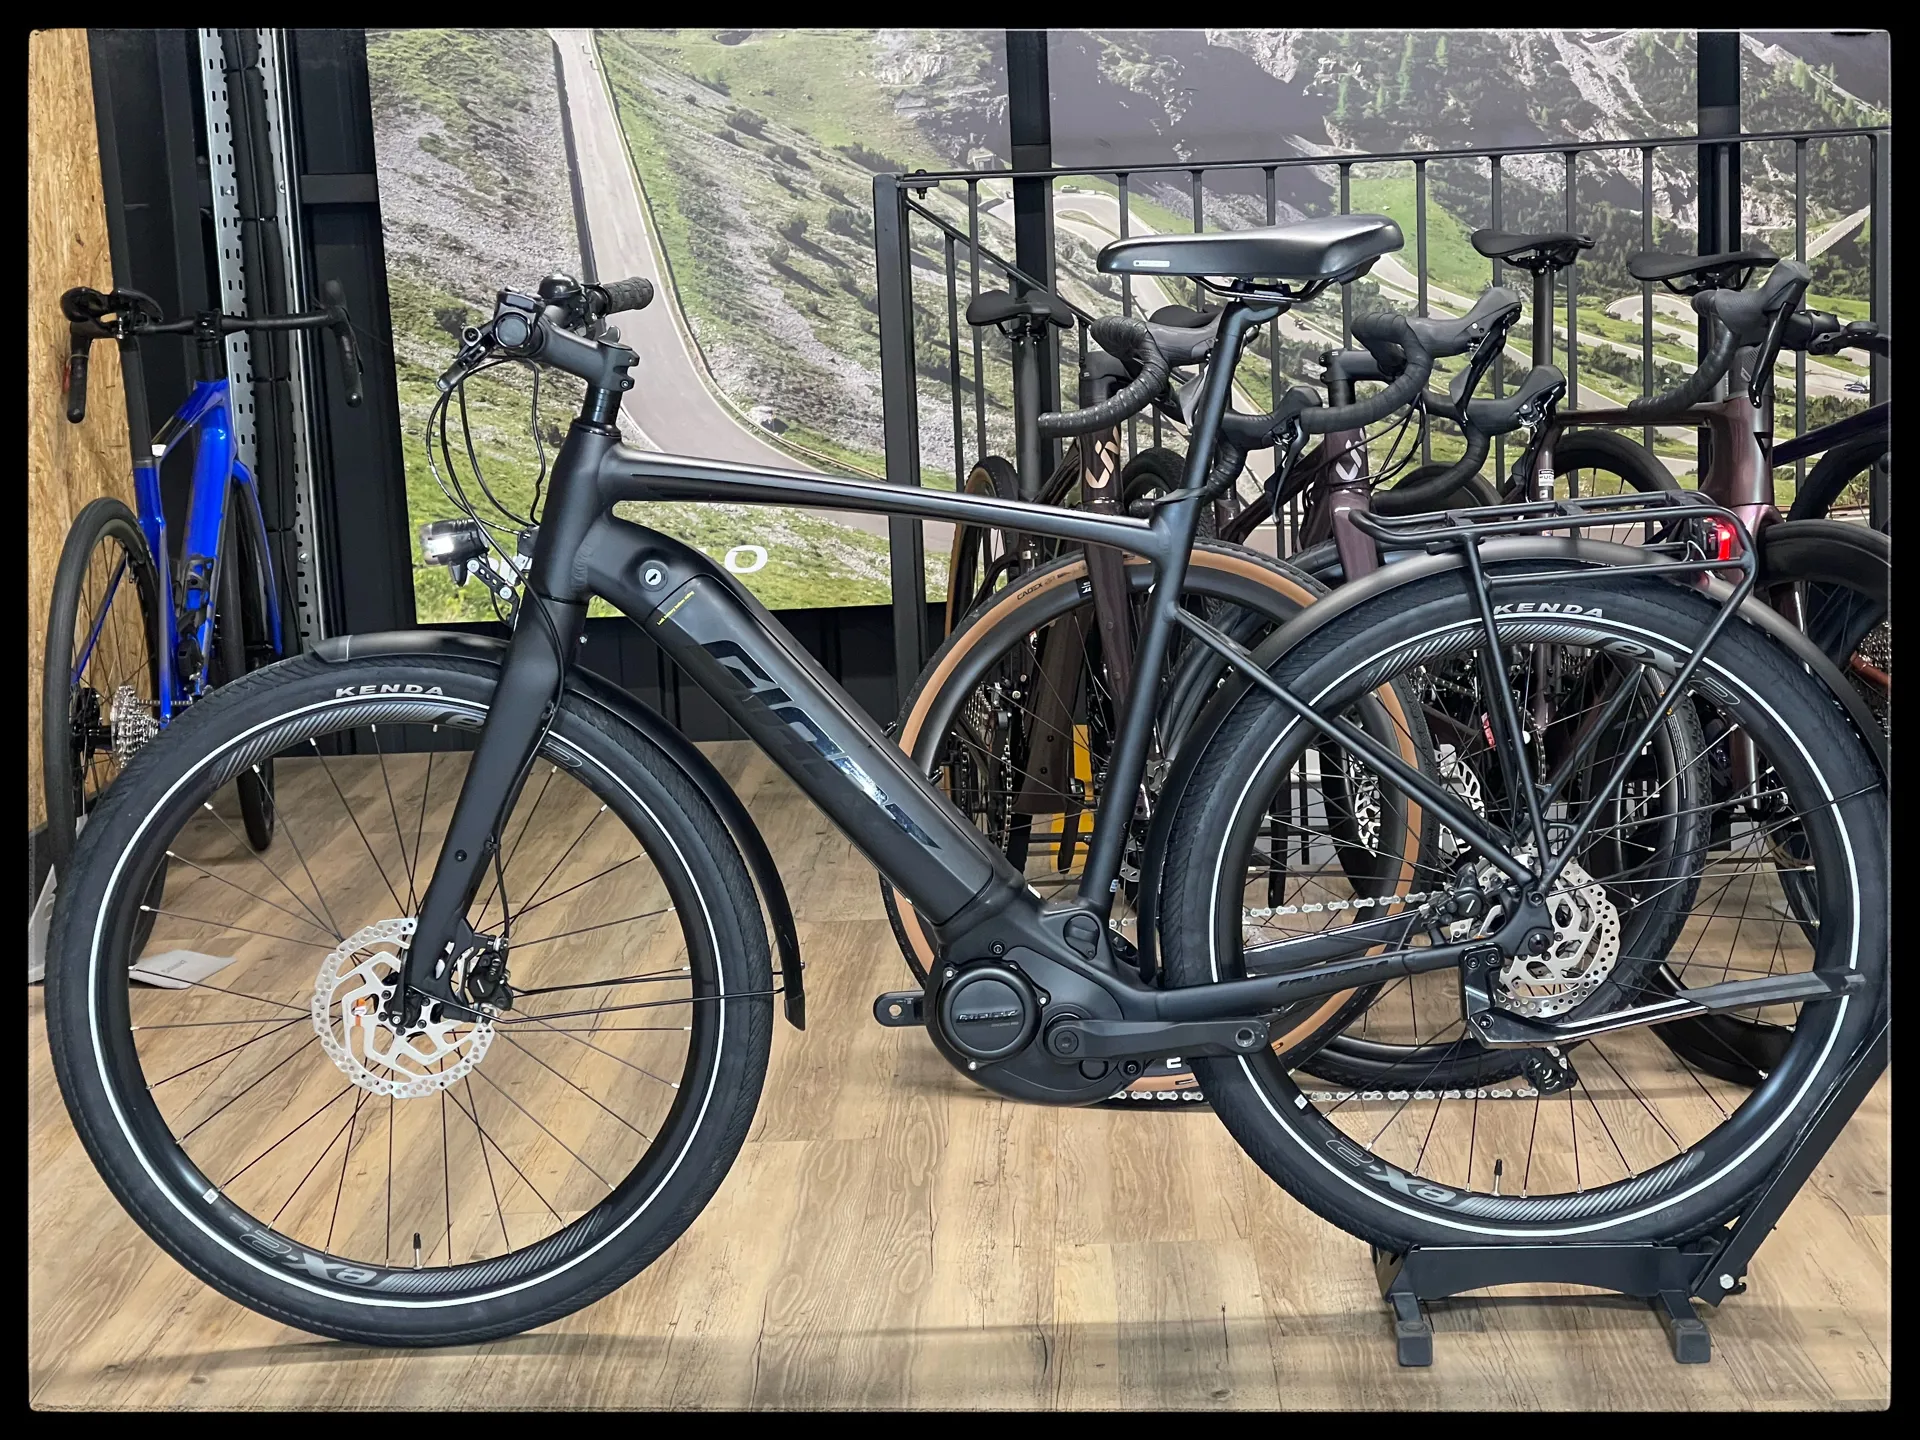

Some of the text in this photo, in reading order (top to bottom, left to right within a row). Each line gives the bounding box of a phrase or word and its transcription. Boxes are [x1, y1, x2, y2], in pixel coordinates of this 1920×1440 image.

[1016, 581, 1043, 601] CADEX
[1493, 602, 1603, 618] KENDA
[335, 683, 444, 698] KENDA
